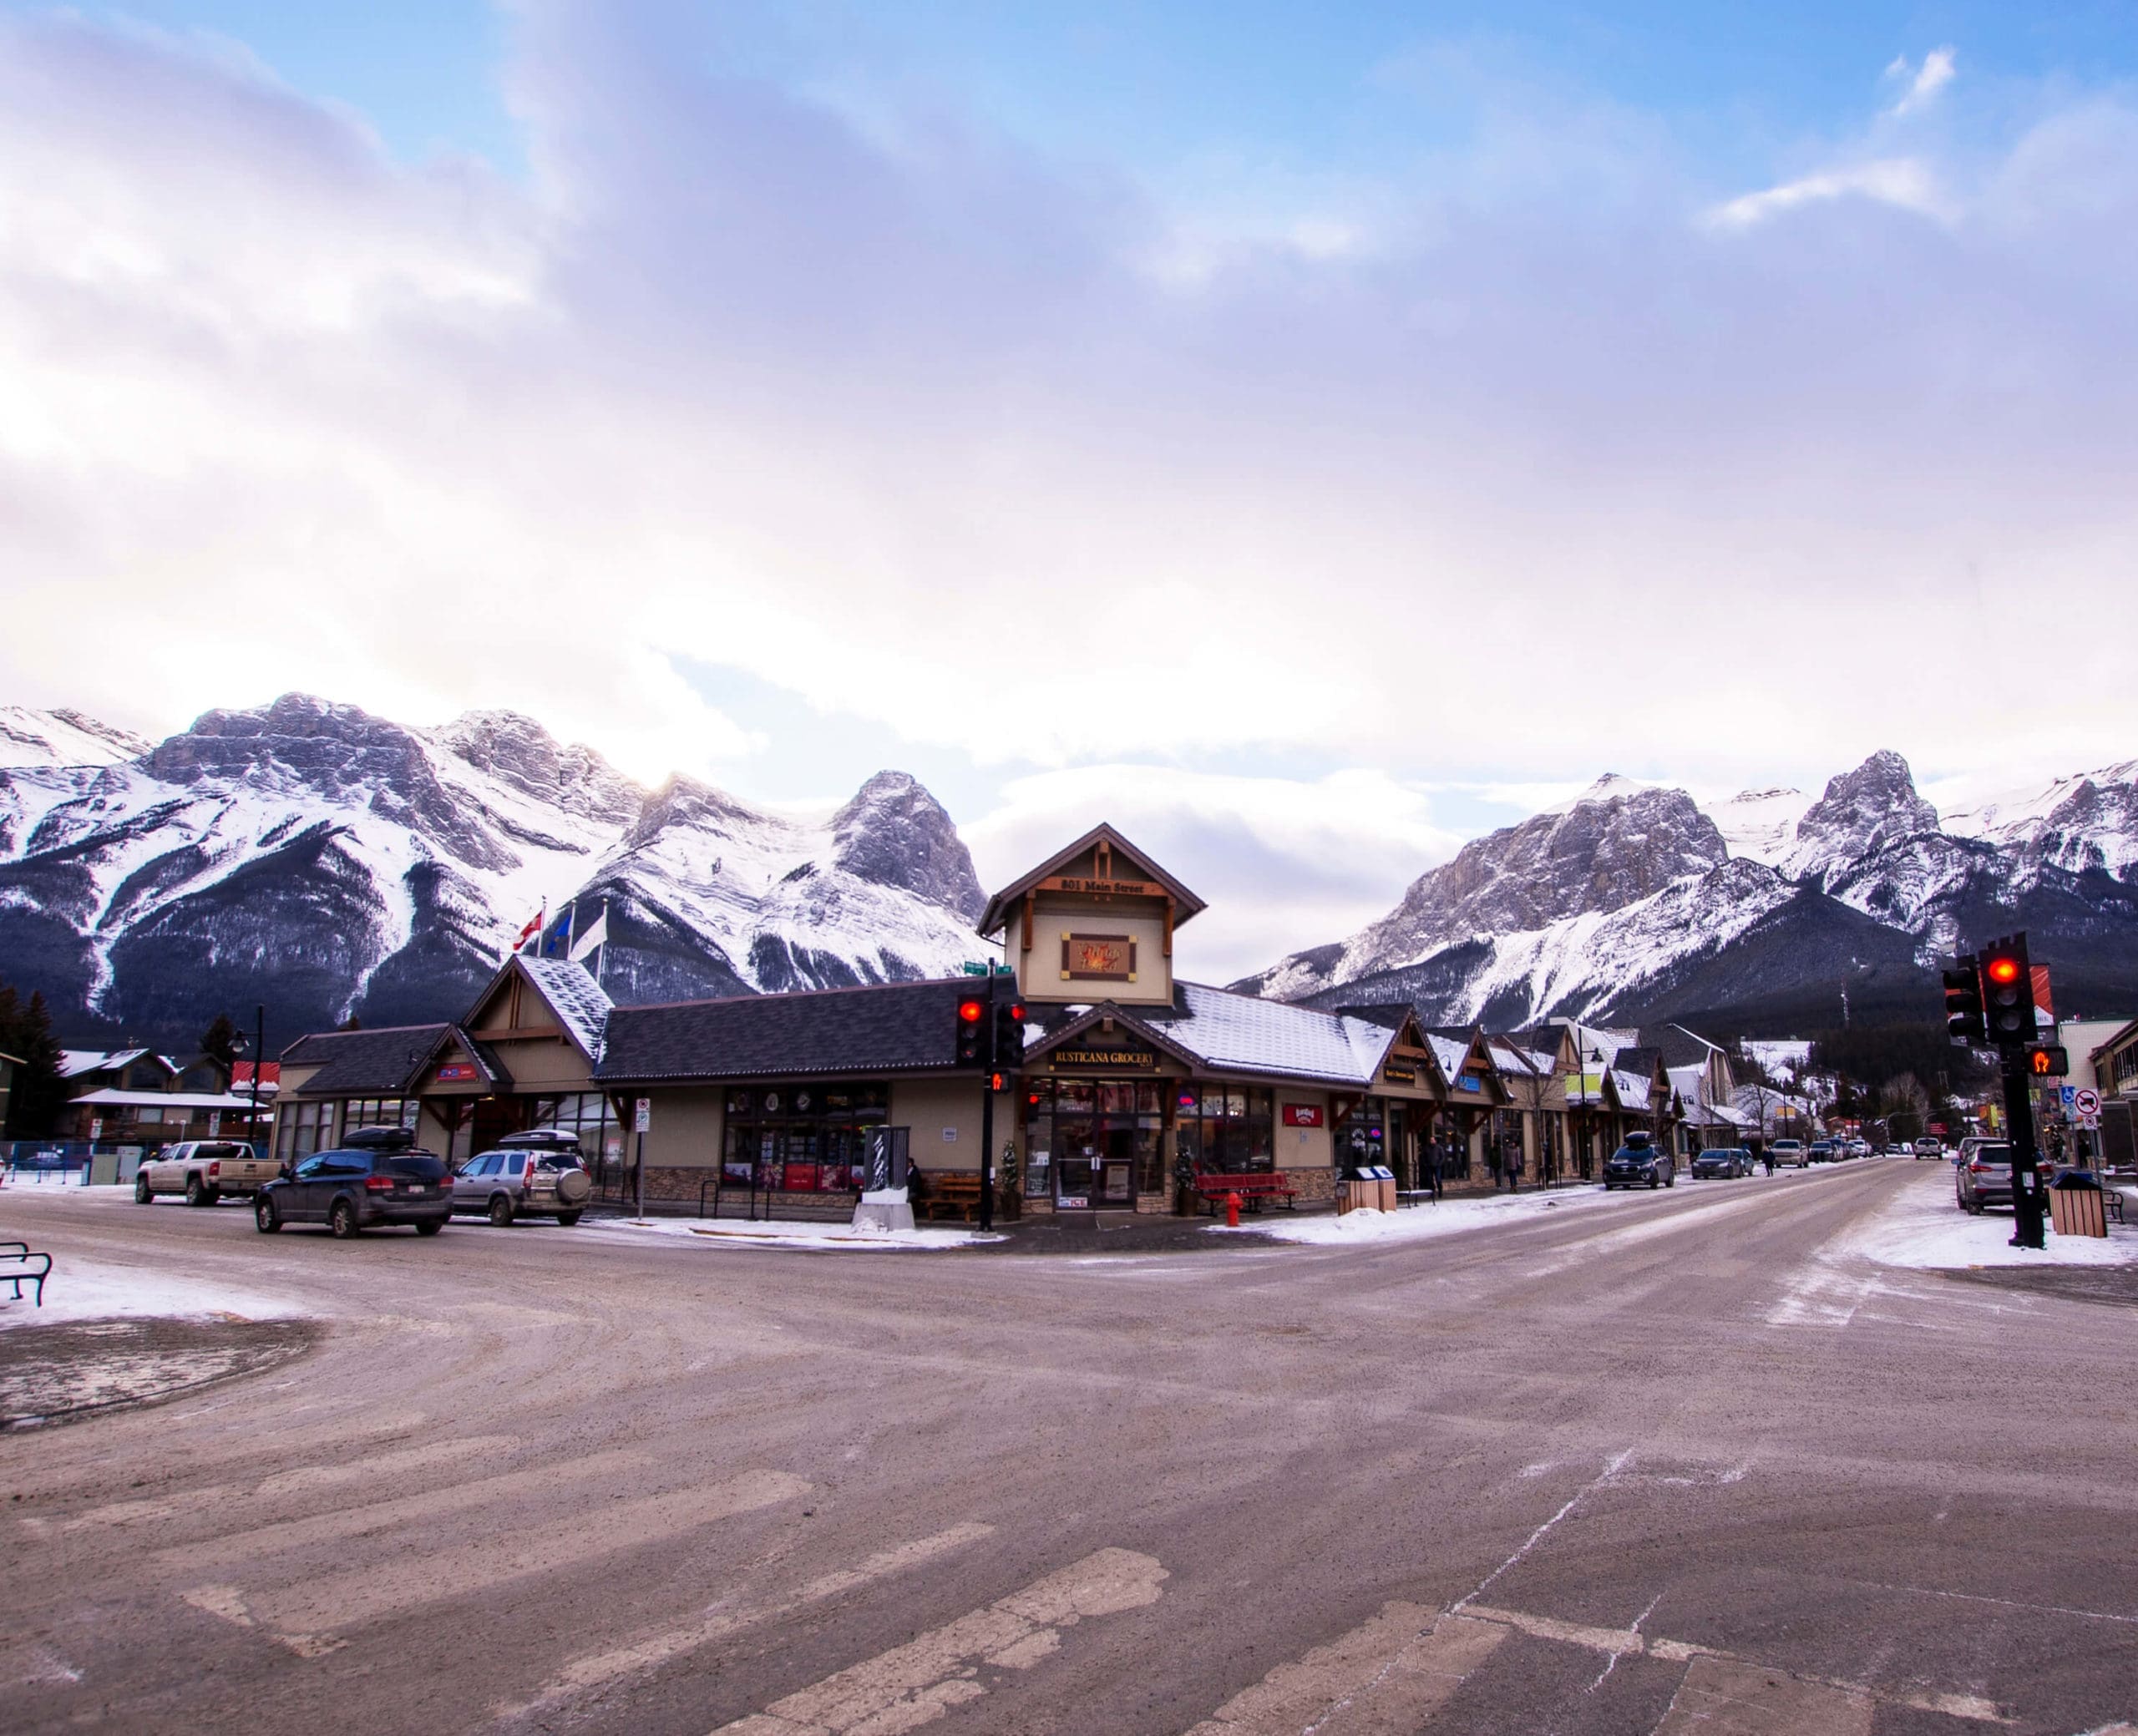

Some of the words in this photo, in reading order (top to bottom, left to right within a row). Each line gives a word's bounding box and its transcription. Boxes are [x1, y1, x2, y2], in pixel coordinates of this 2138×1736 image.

[1085, 881, 1111, 892] Main
[1114, 883, 1143, 893] Street
[1056, 1051, 1108, 1062] RUSTICANA
[1111, 1052, 1153, 1063] GROCERY
